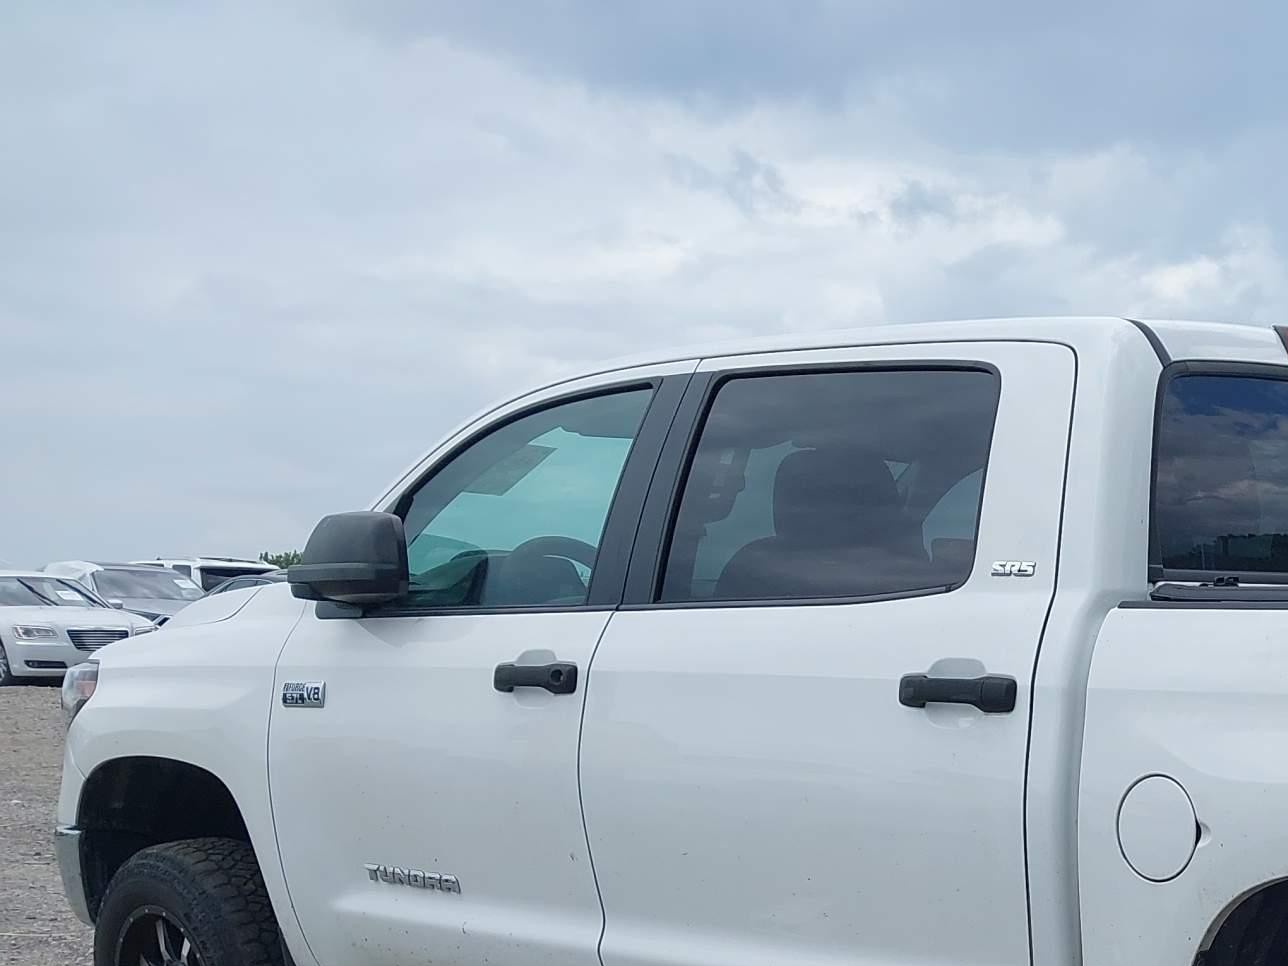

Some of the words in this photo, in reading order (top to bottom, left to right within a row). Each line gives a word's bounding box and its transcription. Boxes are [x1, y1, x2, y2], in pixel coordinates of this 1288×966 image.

[991, 560, 1036, 577] SR5
[306, 686, 321, 701] V8
[363, 863, 462, 895] TUNDRA
